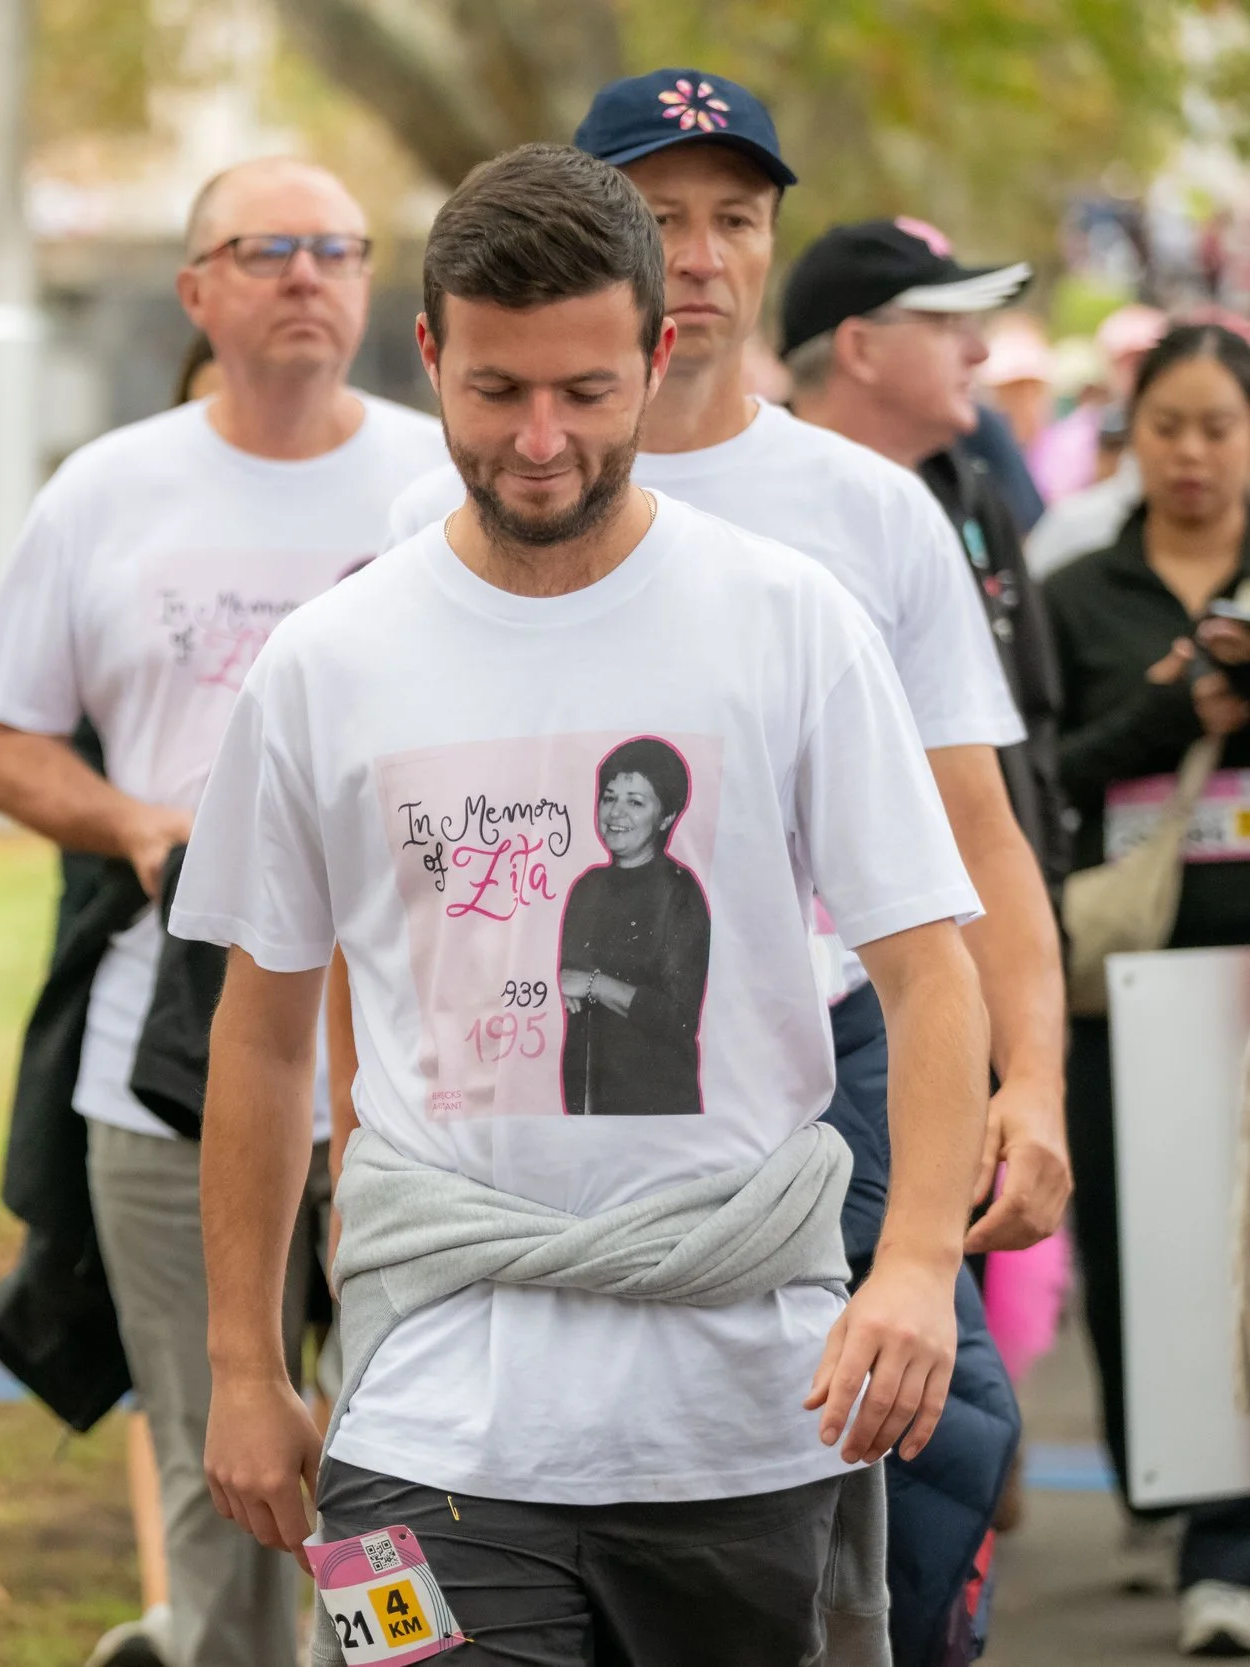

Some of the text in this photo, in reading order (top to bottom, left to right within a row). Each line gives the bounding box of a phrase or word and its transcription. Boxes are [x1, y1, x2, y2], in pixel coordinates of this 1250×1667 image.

[398, 794, 571, 857] In Memory
[423, 834, 556, 921] of Zita
[386, 1589, 409, 1616] 4
[329, 1610, 375, 1649] 21
[388, 1616, 423, 1639] KM
